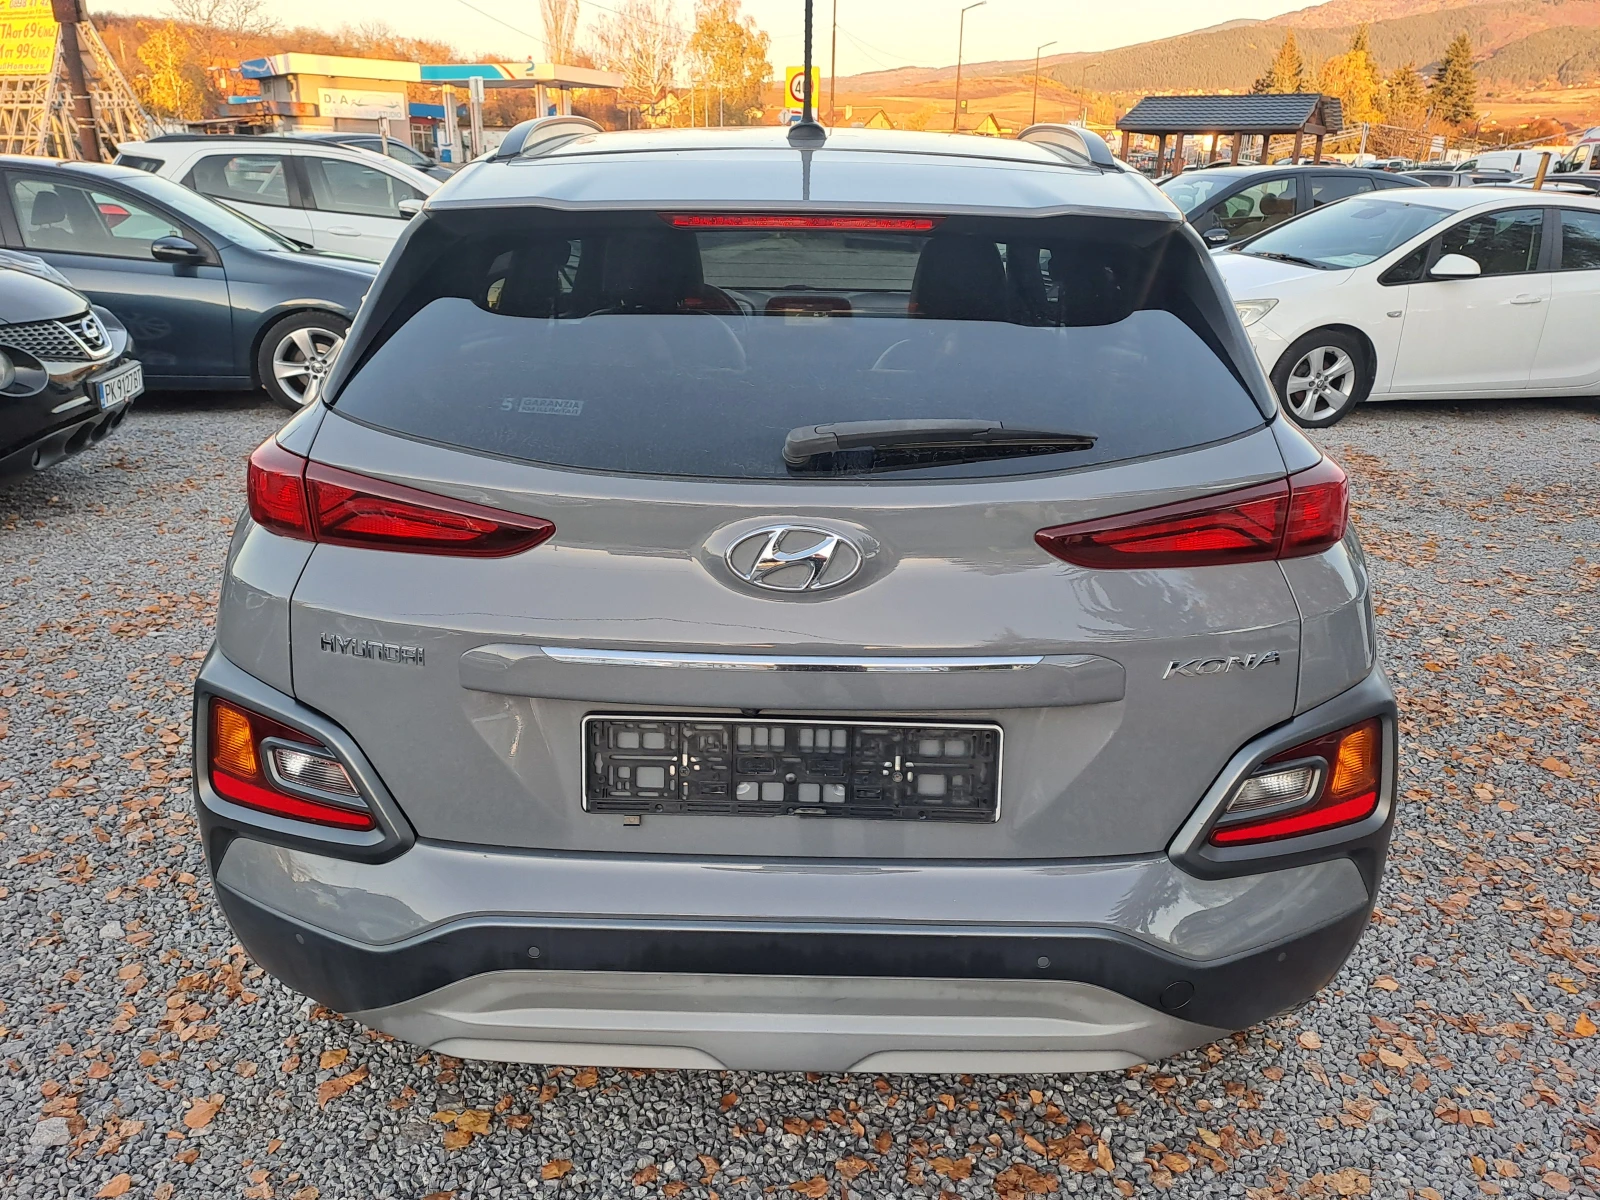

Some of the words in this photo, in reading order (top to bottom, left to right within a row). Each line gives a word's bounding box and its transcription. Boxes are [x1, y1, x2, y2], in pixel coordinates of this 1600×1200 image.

[523, 400, 579, 409] GARANZIA
[320, 632, 426, 666] HYUNDAI
[1161, 649, 1280, 680] KONA
